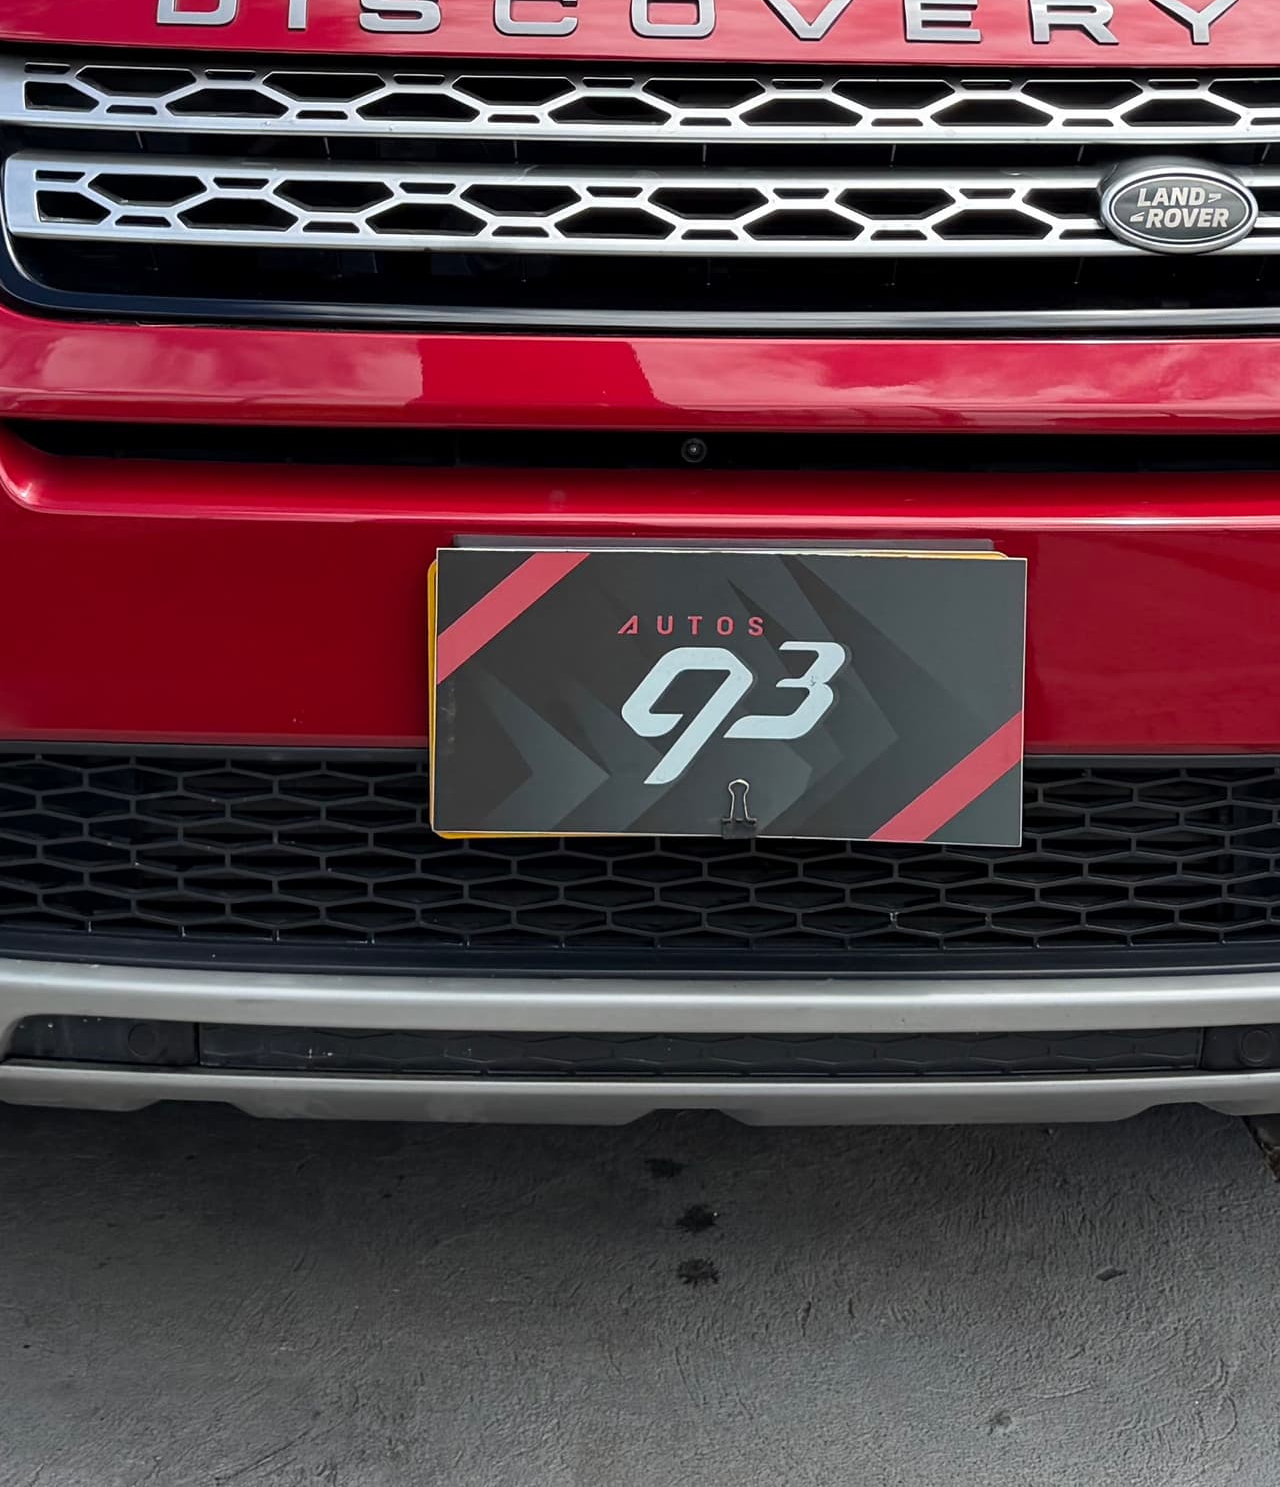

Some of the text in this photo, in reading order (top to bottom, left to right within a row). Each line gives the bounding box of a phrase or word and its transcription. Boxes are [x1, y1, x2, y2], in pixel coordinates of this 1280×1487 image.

[1137, 186, 1206, 207] LAND
[1145, 208, 1229, 229] ROVER
[618, 615, 765, 636] AUTOS
[621, 641, 846, 785] 93
